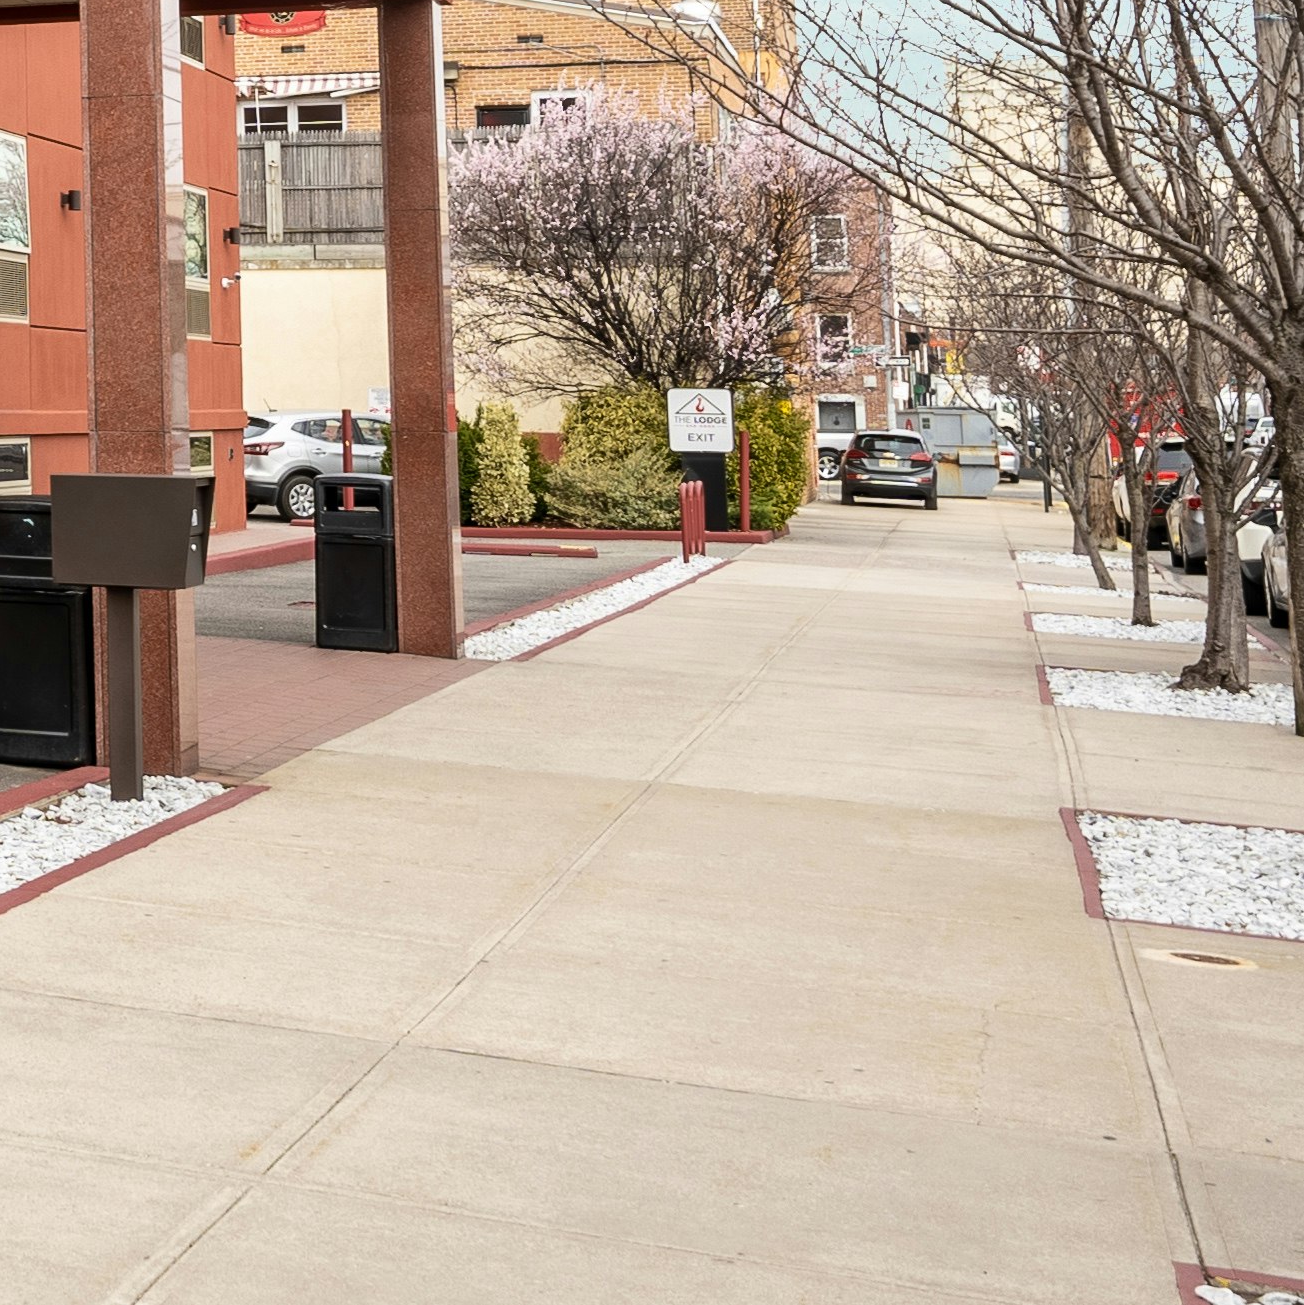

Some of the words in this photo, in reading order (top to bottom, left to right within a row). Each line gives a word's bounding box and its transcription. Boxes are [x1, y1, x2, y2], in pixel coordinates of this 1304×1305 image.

[674, 416, 691, 424] THE
[694, 416, 727, 424] LODGE
[687, 433, 715, 442] EXIT
